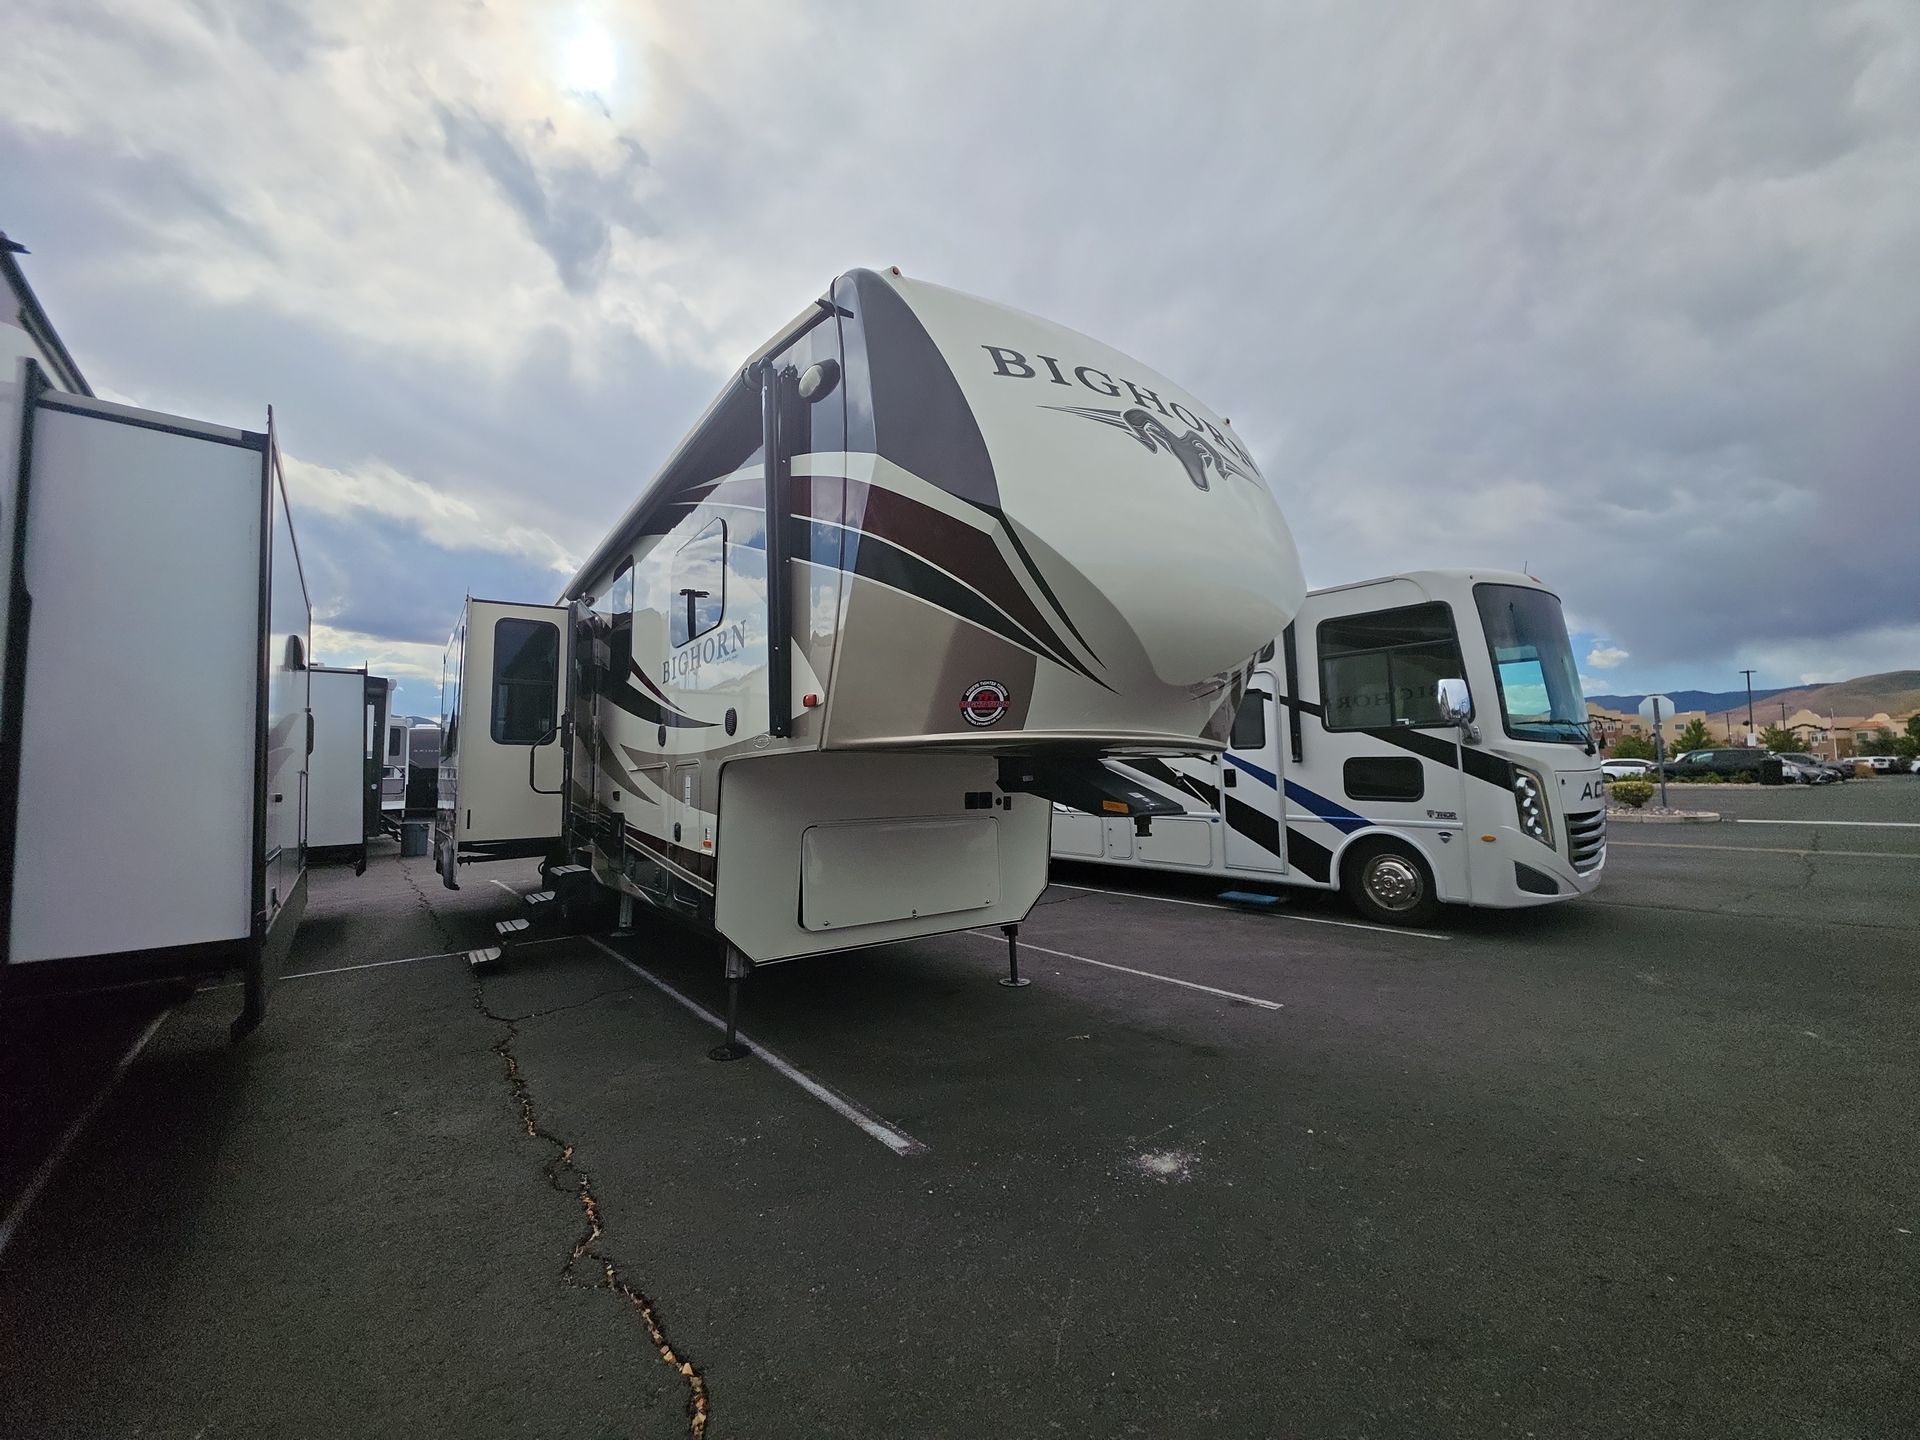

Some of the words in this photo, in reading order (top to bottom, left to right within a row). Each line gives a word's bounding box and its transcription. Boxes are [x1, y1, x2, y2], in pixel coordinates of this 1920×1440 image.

[981, 345, 1261, 477] BIGHORN
[662, 619, 747, 684] BIGHORN
[1580, 781, 1603, 801] AC
